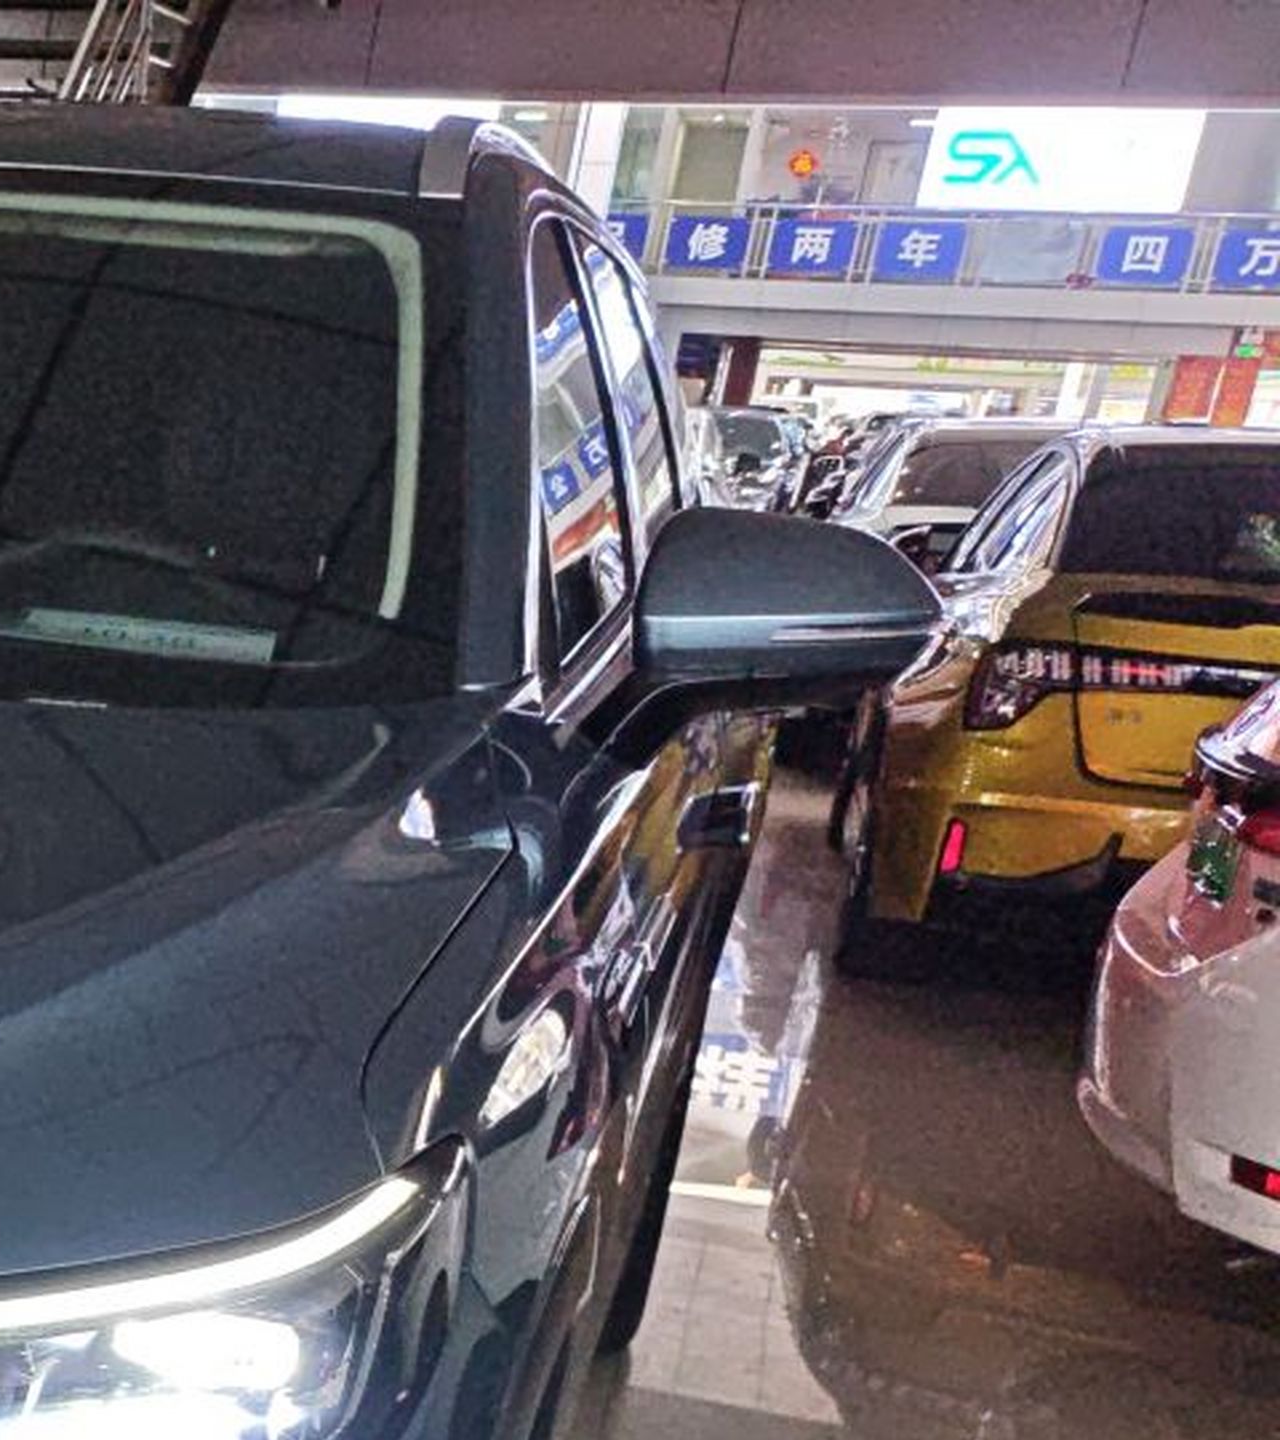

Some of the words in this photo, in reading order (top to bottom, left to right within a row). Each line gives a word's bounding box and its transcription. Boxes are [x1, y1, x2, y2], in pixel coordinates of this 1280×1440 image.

[687, 222, 729, 261] 修
[790, 226, 836, 264] 两
[896, 229, 942, 268] 年
[1120, 235, 1169, 273] 四
